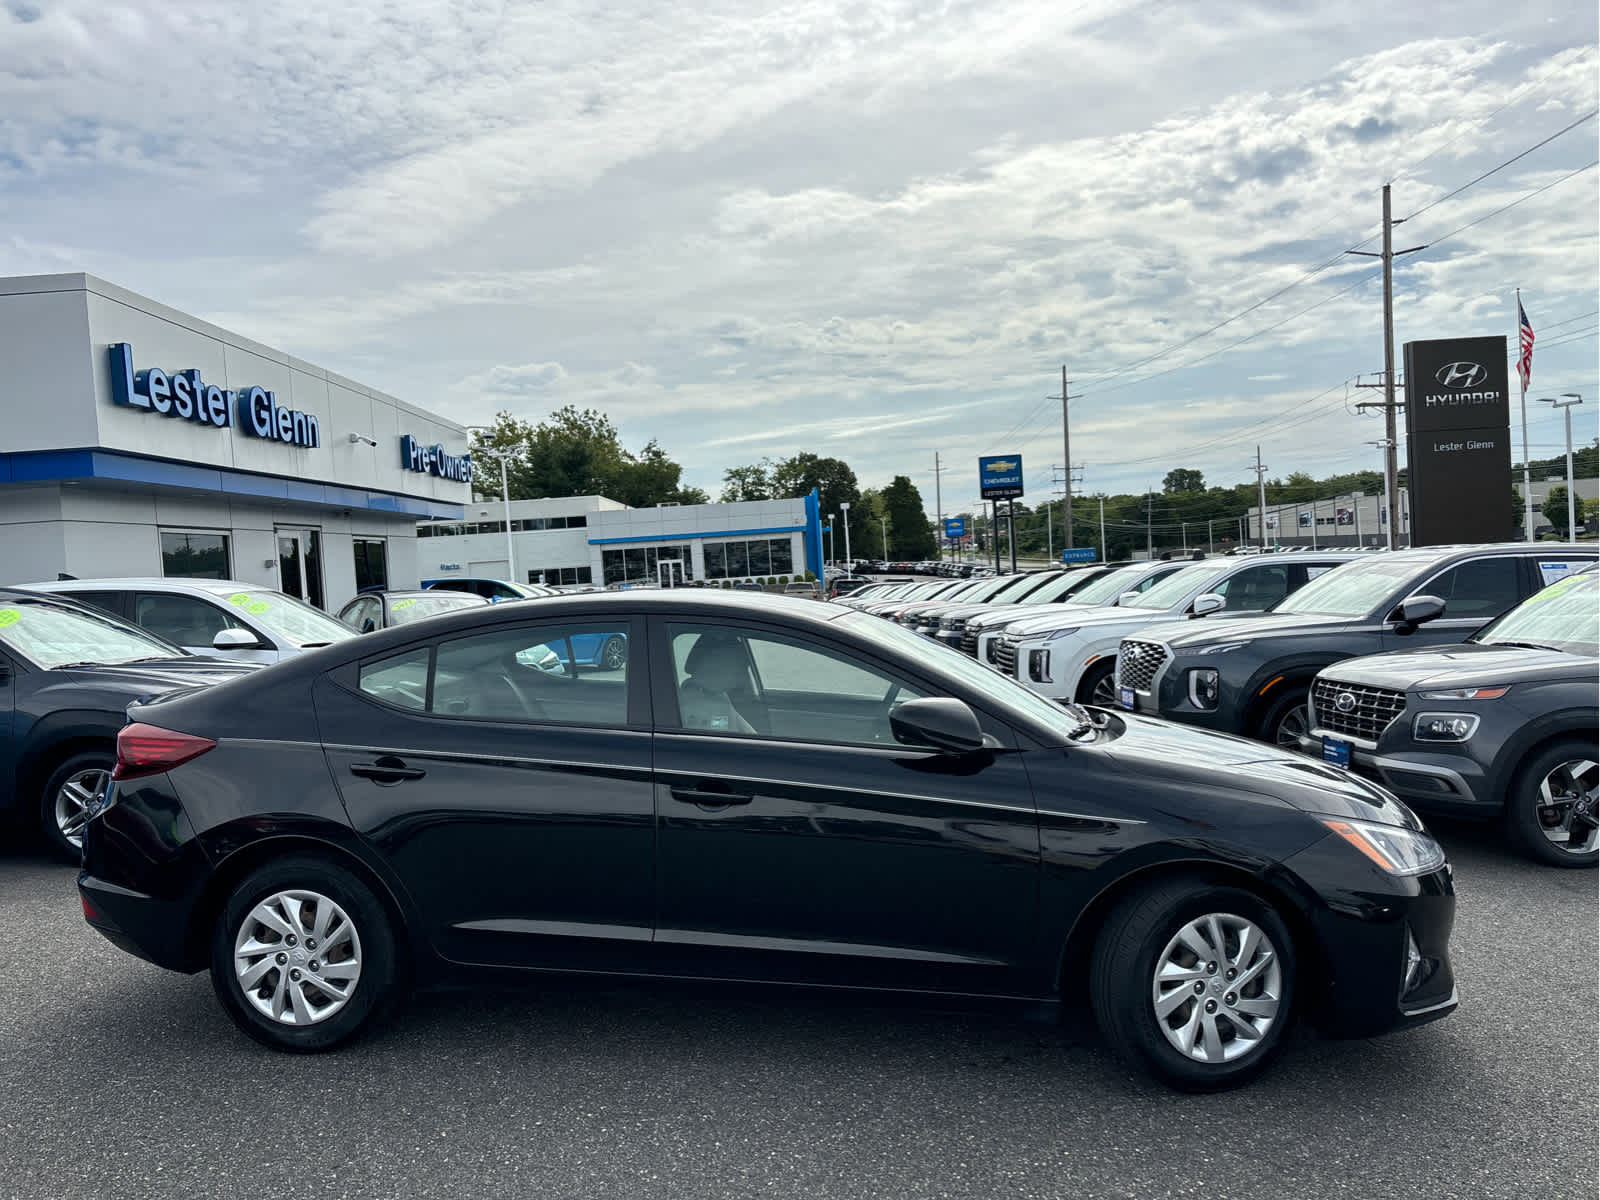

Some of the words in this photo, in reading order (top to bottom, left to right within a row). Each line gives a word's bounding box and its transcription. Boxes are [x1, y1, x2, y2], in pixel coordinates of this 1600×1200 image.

[110, 343, 236, 428] Lester
[241, 385, 320, 448] Glenn
[1425, 391, 1500, 407] HYUNDAI
[401, 433, 473, 482] Pre-Owned
[1433, 442, 1463, 452] Lester
[1467, 440, 1494, 450] Glenn
